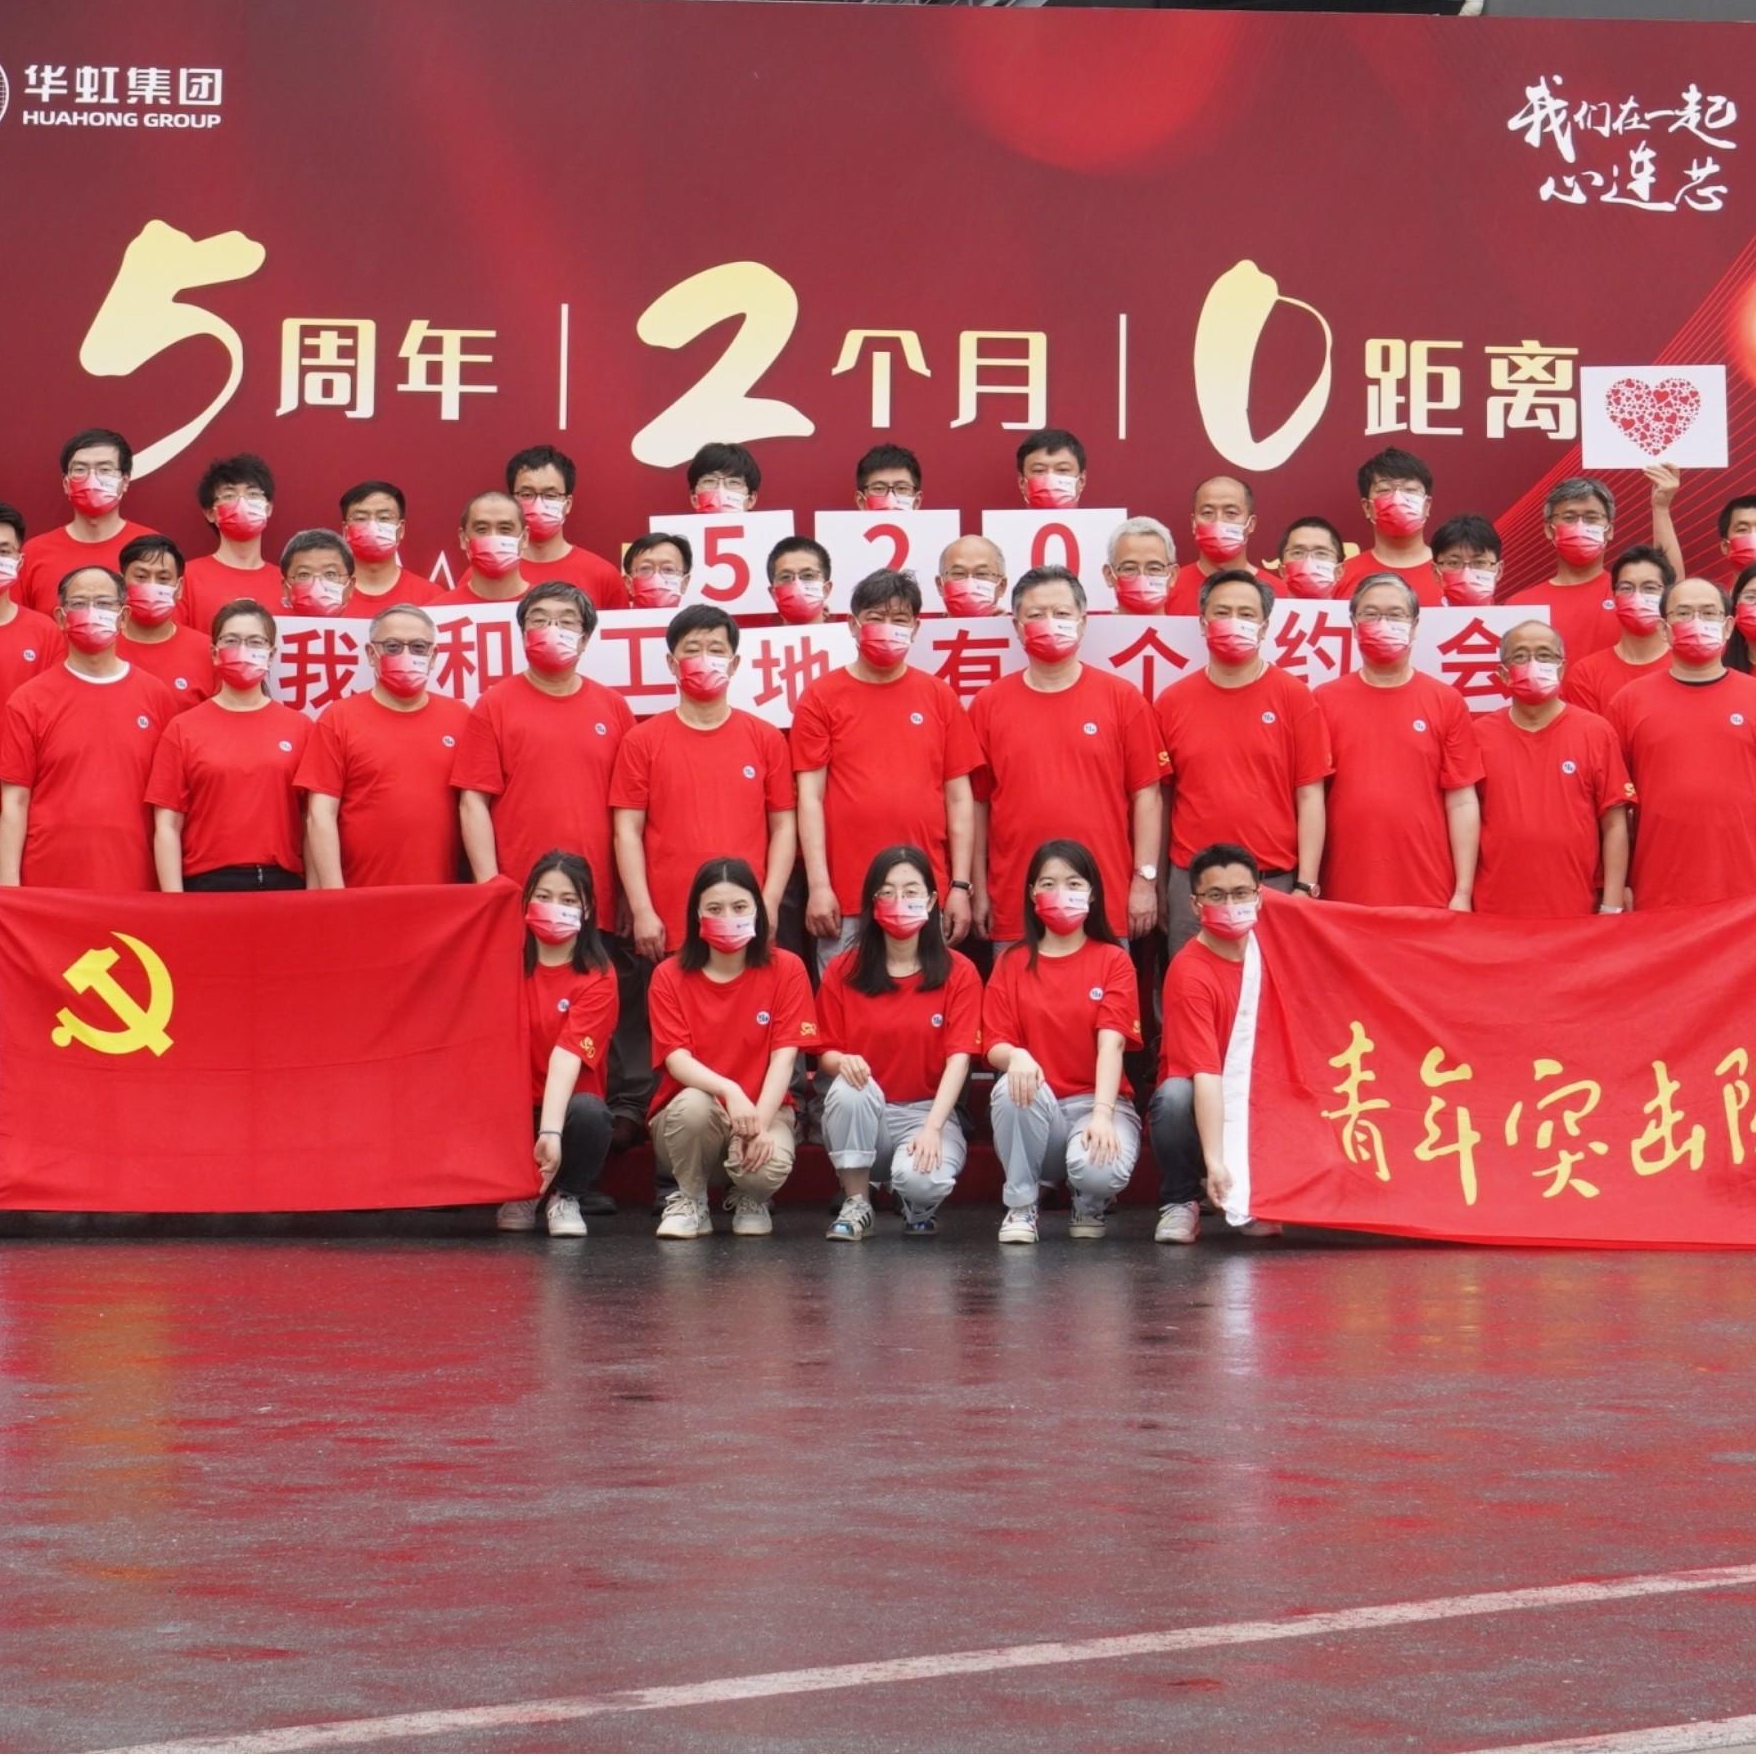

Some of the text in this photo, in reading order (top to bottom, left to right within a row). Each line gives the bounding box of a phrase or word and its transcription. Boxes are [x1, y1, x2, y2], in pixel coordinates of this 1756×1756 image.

[24, 64, 223, 106] 华虹集团
[22, 110, 222, 129] HUAHONG GROUP
[1508, 75, 1737, 163] 我们在一起
